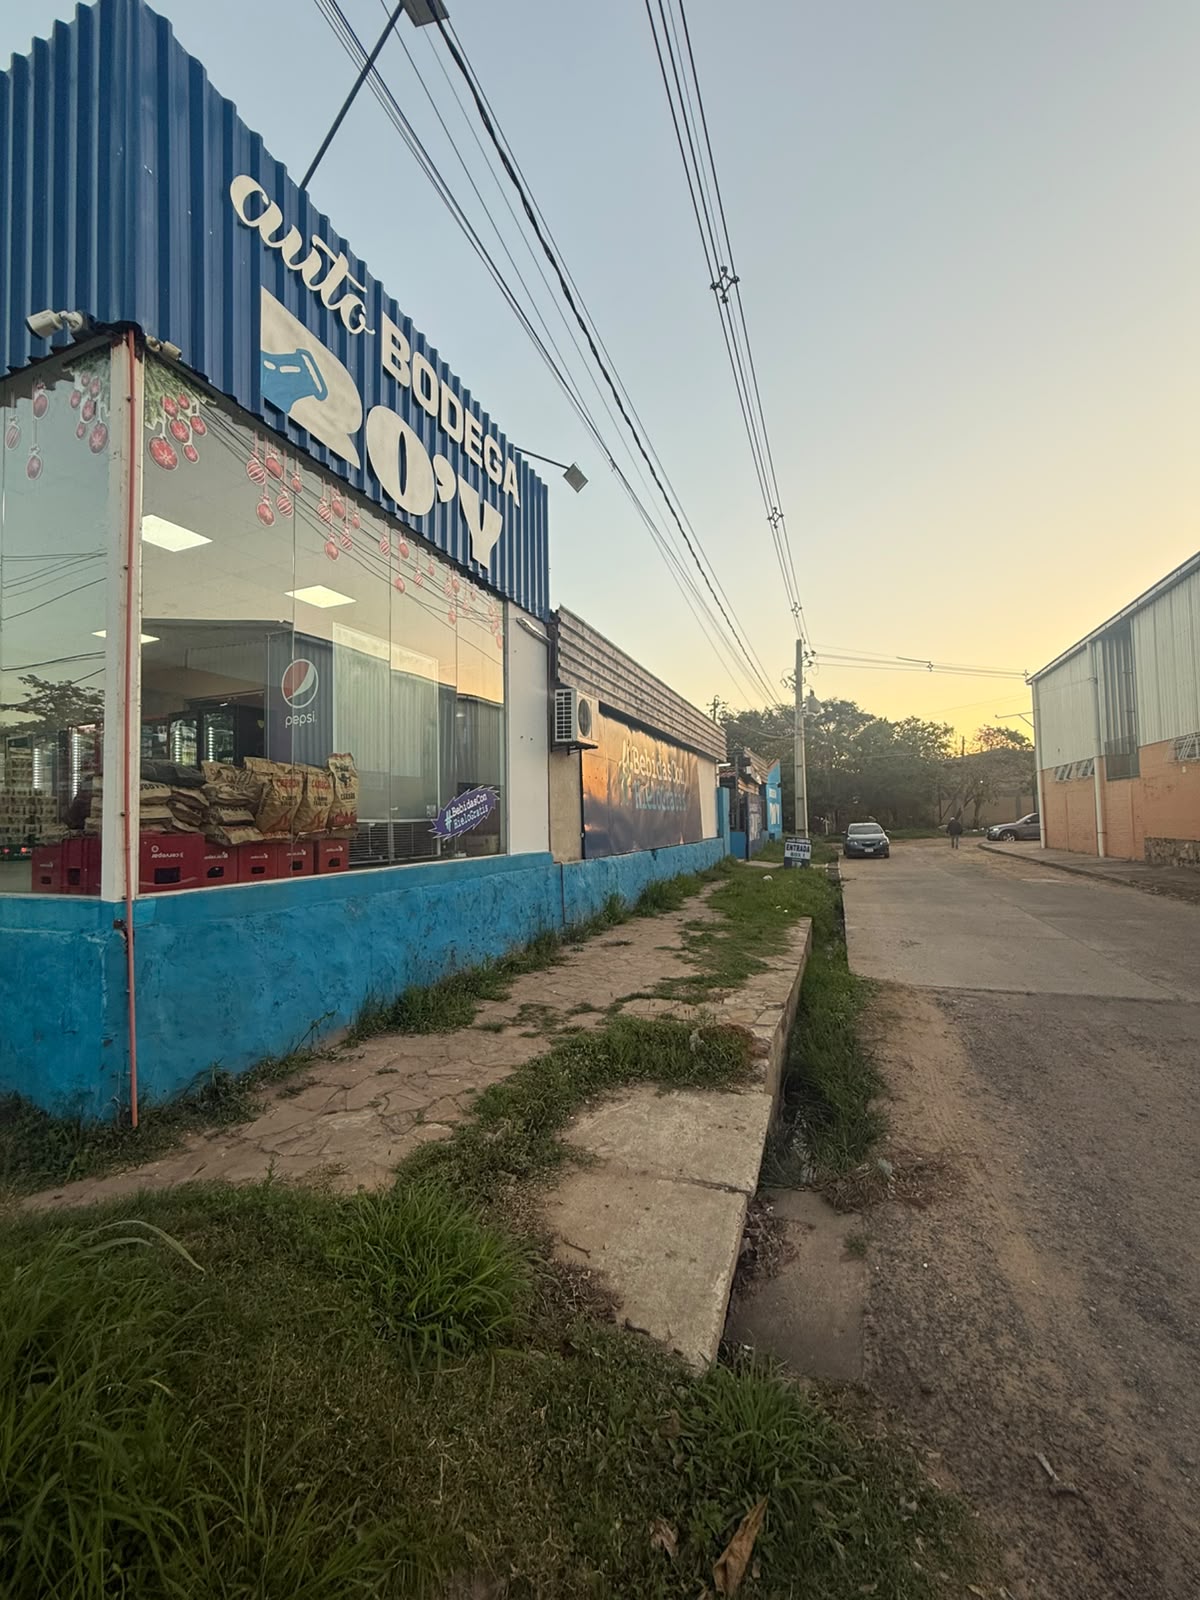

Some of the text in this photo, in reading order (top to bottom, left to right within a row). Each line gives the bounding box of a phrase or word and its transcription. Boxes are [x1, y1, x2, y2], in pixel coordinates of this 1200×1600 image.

[230, 174, 375, 335] auto
[381, 311, 521, 507] BODEGA
[285, 711, 315, 729] pepsi
[444, 793, 488, 833] #BebidasCon
